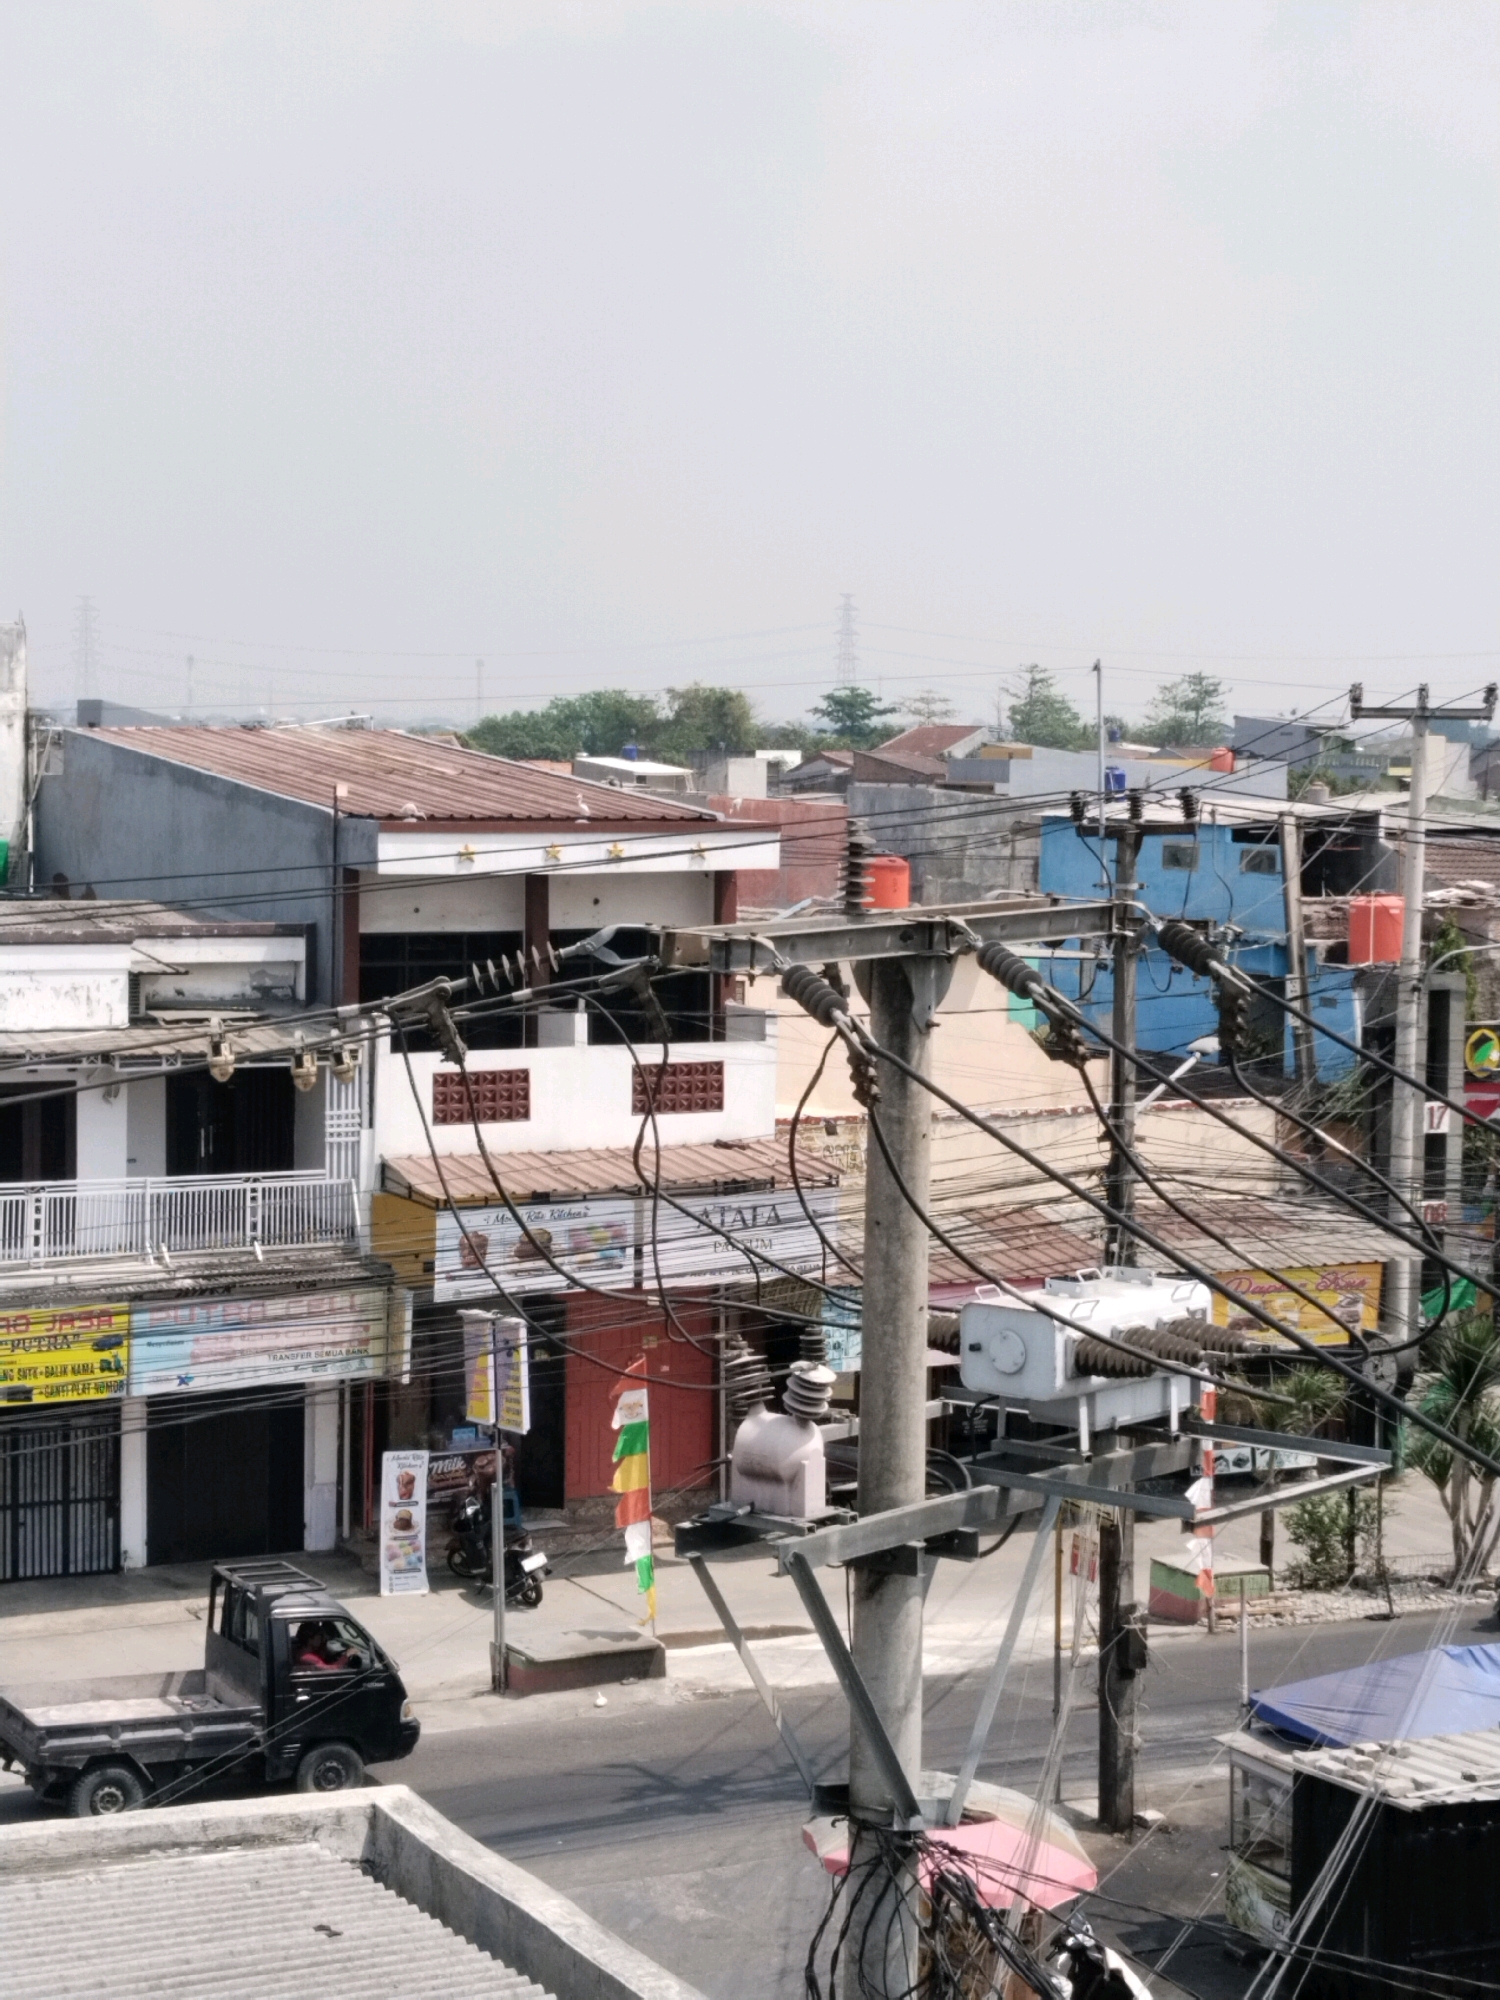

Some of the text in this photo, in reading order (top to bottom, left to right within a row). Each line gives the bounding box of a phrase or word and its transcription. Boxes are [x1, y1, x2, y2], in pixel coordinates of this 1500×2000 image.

[1427, 1105, 1449, 1131] 17
[268, 1351, 312, 1362] TRANSFER
[315, 1349, 344, 1359] SEMUA
[345, 1347, 370, 1357] BANK
[429, 1456, 467, 1474] Milk
